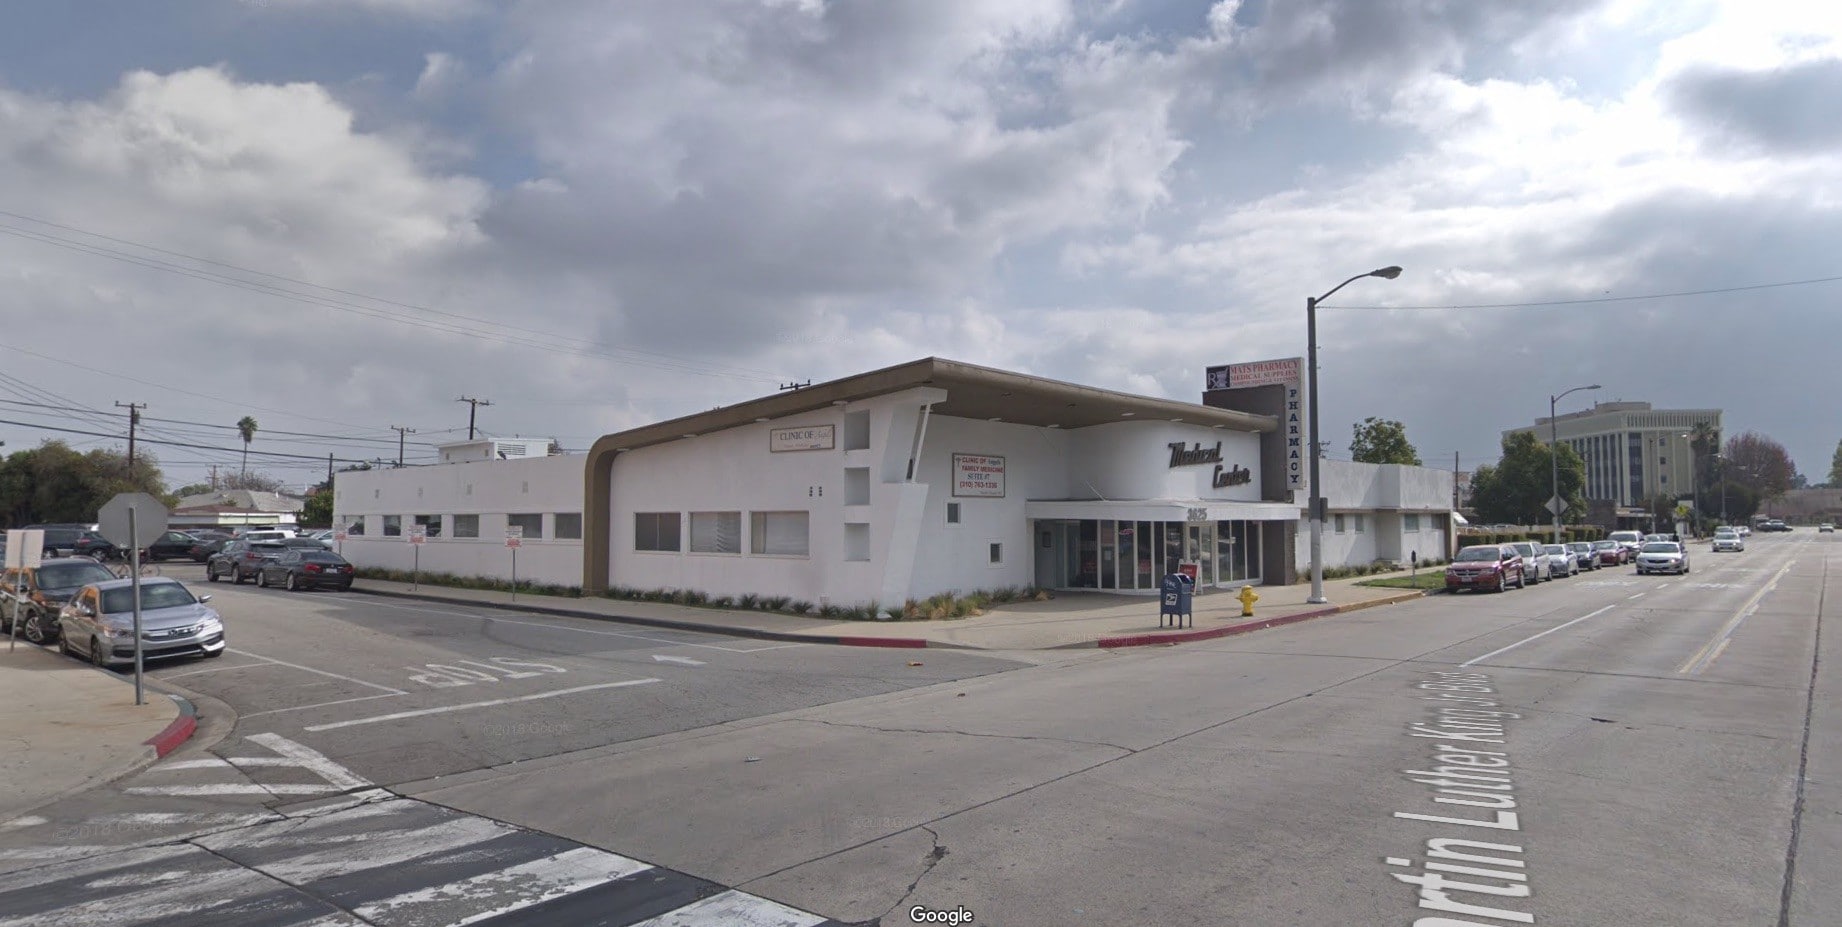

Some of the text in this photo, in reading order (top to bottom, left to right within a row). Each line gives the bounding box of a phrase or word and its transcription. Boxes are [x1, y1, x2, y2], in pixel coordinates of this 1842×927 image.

[1231, 369, 1297, 381] MEDICAL SUPPLIES
[1253, 361, 1298, 372] PHARMACY
[780, 430, 803, 441] CLINIC
[804, 430, 815, 440] OF
[1288, 389, 1299, 483] PHARMACY
[962, 456, 979, 464] CLINIC
[1168, 441, 1223, 468] Medical
[1212, 464, 1252, 488] Center
[403, 657, 567, 688] STOP
